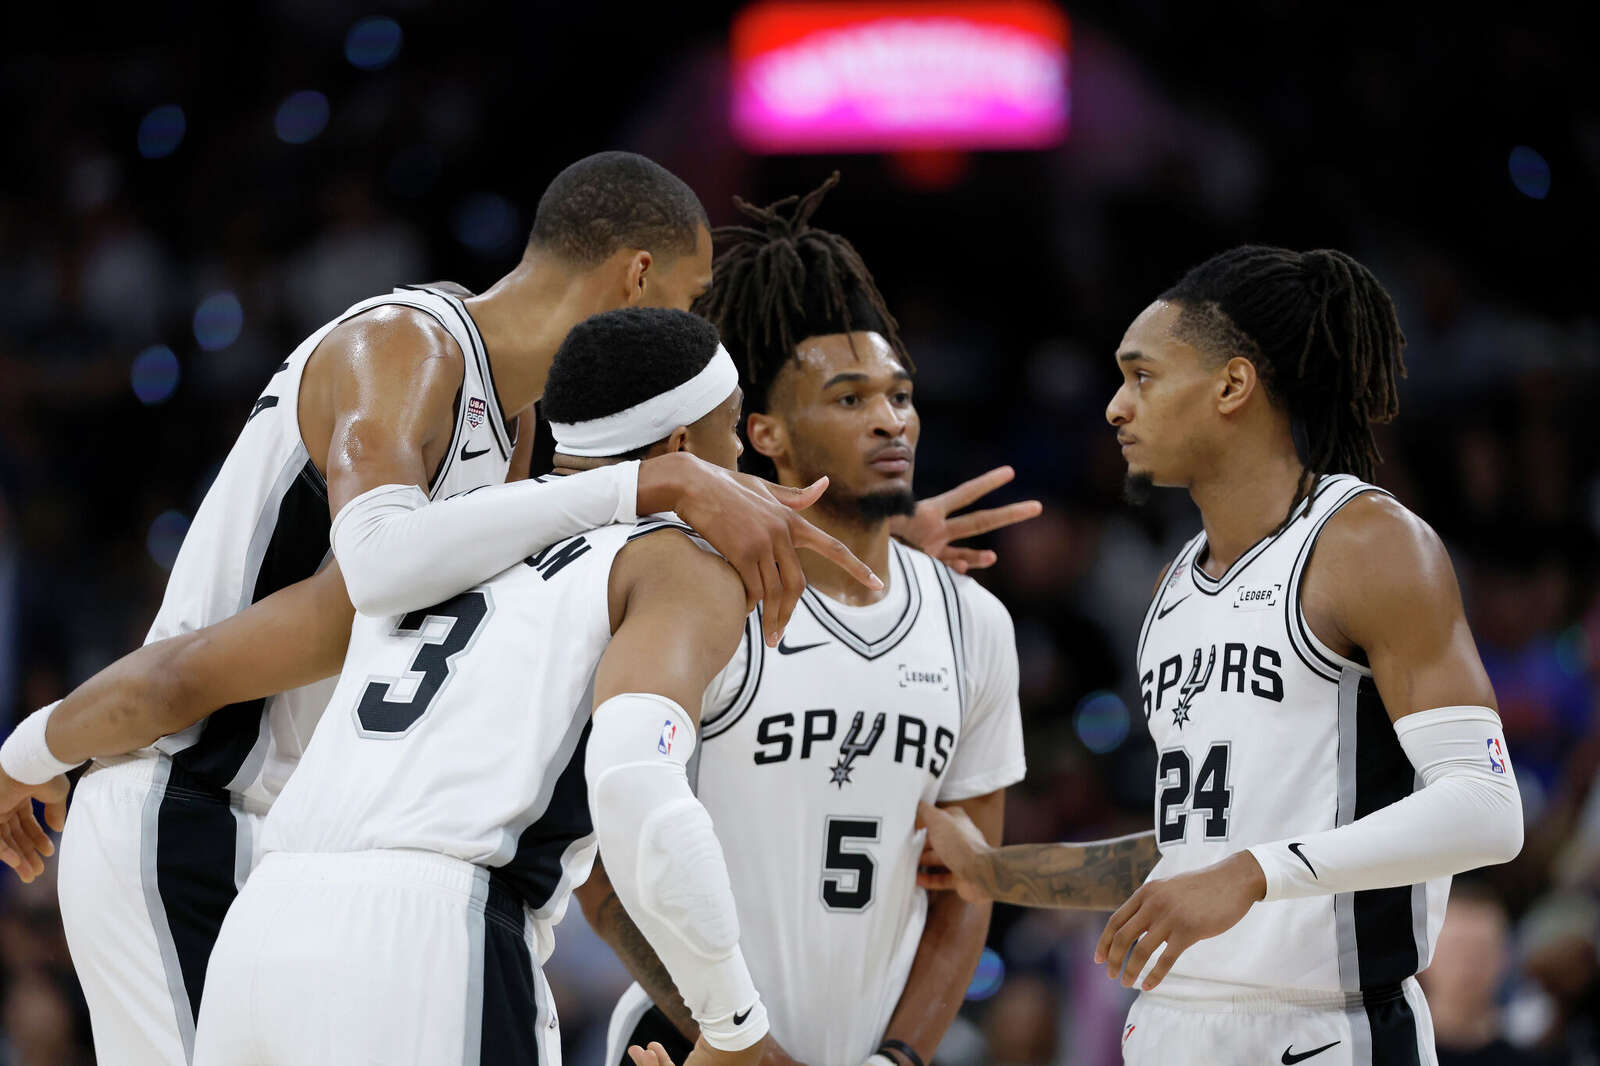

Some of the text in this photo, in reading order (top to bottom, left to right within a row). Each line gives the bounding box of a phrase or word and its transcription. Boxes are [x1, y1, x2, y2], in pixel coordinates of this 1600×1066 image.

[467, 412, 484, 424] 250
[470, 399, 485, 410] USA
[1239, 590, 1273, 601] LEDGER
[351, 587, 496, 740] 3
[905, 671, 942, 684] LEDGER
[1140, 643, 1284, 729] SPURS
[753, 709, 954, 788] SPURS
[1157, 741, 1233, 846] 24
[820, 816, 882, 913] 5
